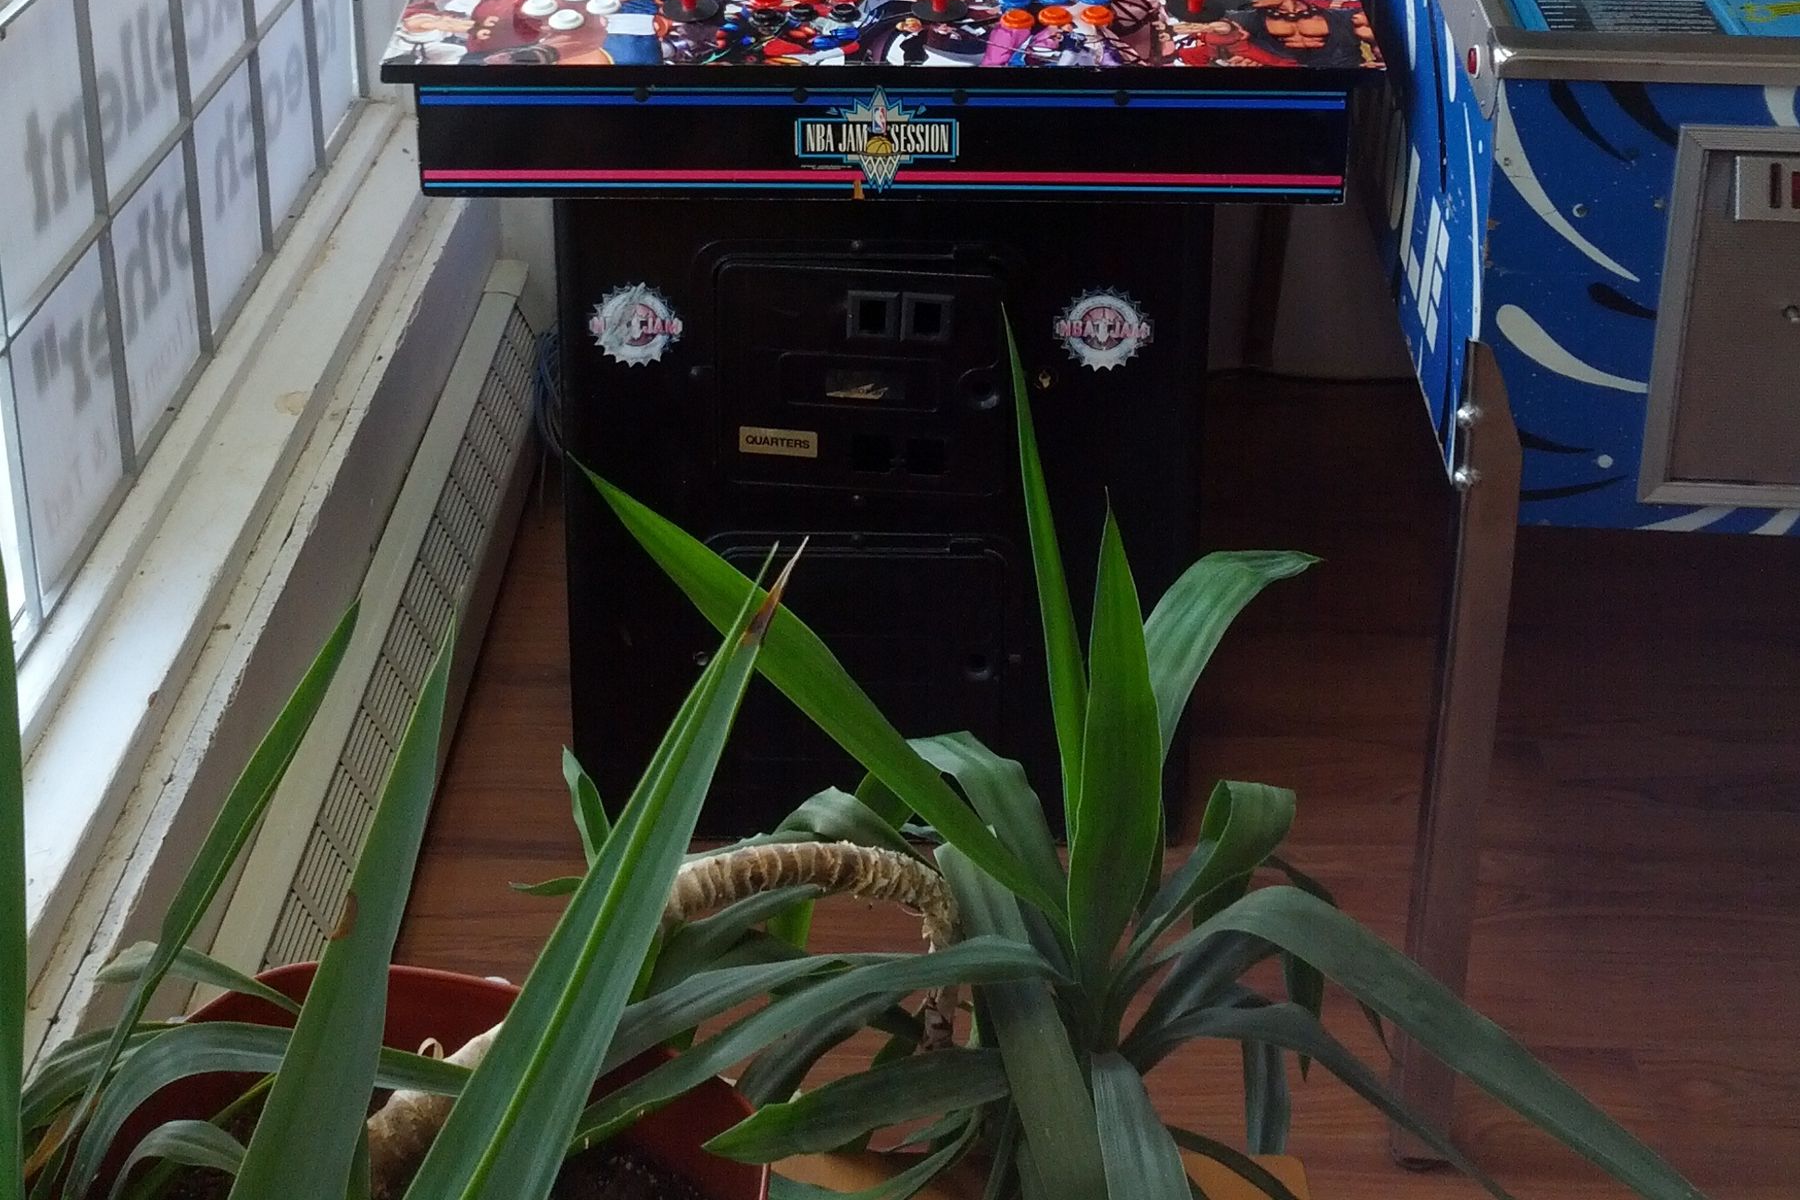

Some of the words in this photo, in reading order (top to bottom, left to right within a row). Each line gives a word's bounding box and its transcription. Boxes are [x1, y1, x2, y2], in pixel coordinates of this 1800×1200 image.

[805, 123, 839, 153] NBA
[838, 123, 868, 153] JAM
[890, 123, 949, 153] SESSION
[1055, 319, 1096, 338] NBA
[745, 434, 810, 450] QUARTERS
